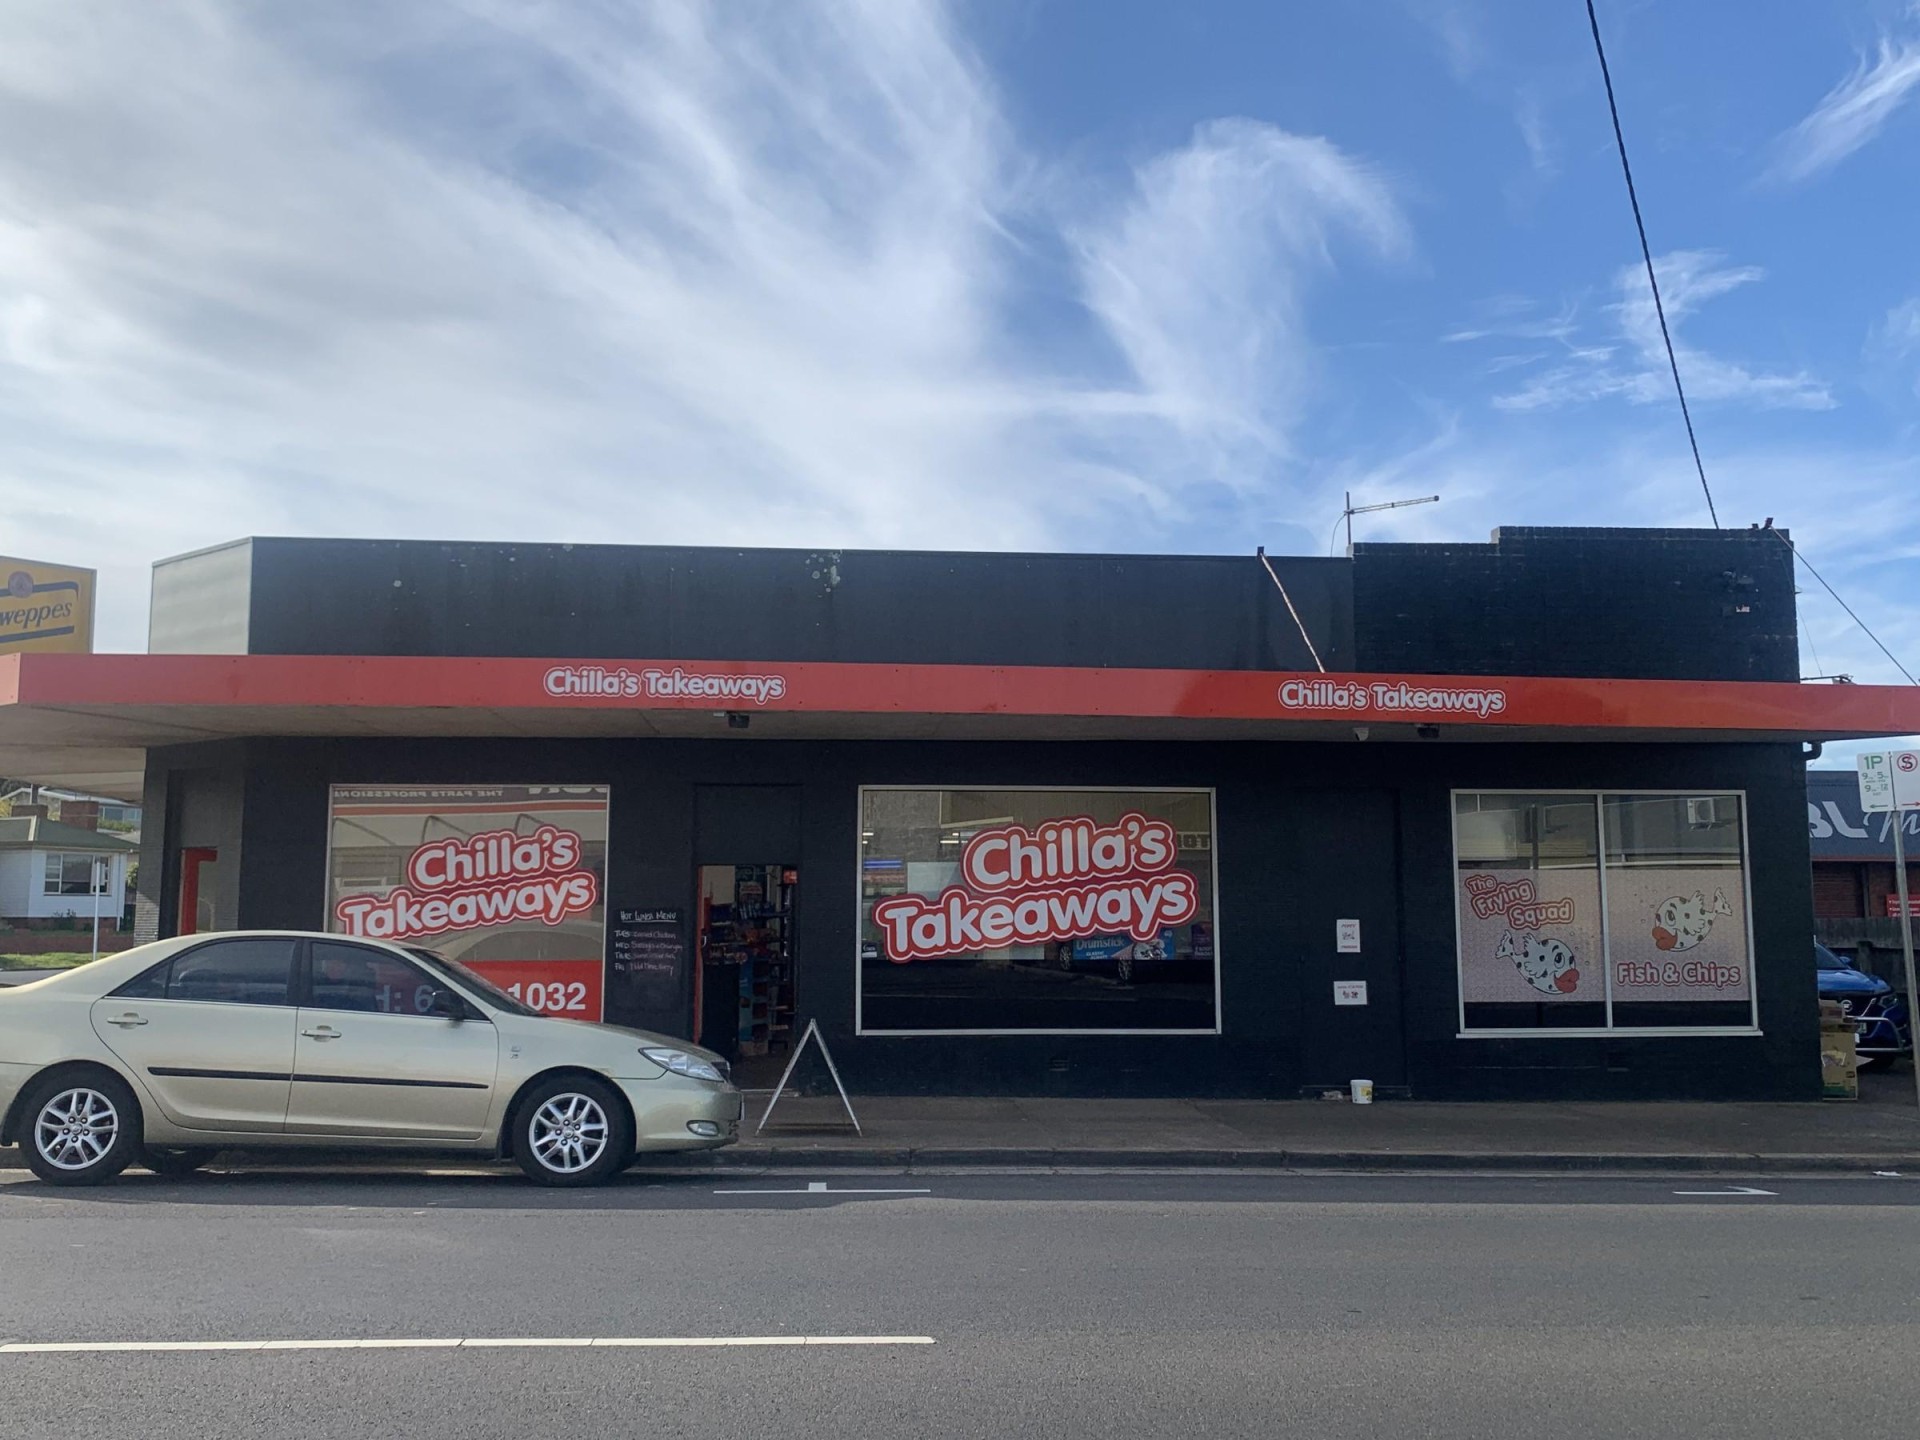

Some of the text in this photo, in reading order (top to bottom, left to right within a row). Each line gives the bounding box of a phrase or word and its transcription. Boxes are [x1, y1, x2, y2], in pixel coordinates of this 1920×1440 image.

[546, 669, 784, 702] Chilla's Takeaways
[1280, 682, 1505, 716] Chilla's Takeaways
[1863, 755, 1884, 770] 1P
[414, 831, 575, 887] Chilla's
[970, 821, 1168, 886] Chilla's
[1469, 878, 1495, 892] The
[1475, 883, 1533, 914] Frying
[343, 877, 591, 937] Takeaways
[883, 880, 1190, 953] Takeaways
[1511, 901, 1572, 928] Squad
[1617, 963, 1742, 989] Fish & Chips
[507, 982, 587, 1012] 1032
